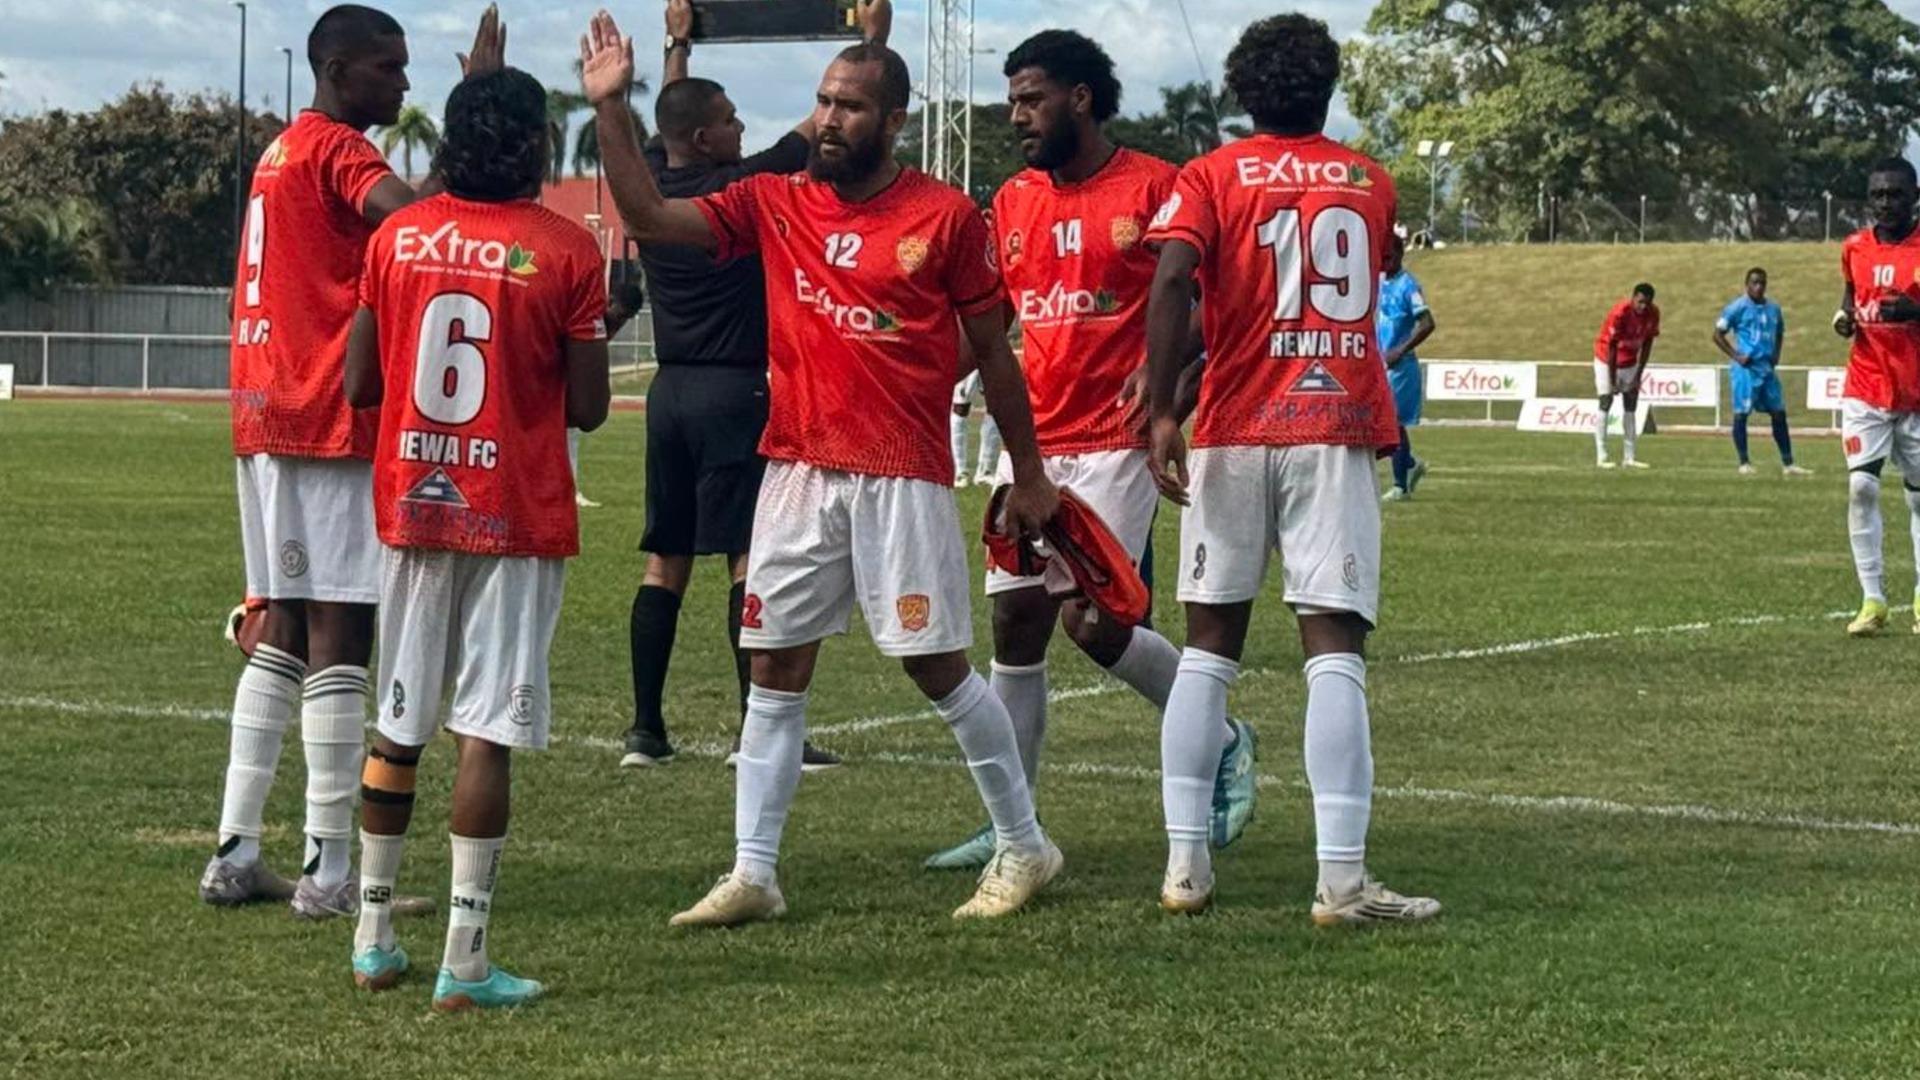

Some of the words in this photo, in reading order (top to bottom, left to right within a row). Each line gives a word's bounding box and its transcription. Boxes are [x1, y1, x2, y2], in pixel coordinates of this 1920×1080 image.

[1236, 151, 1349, 187] Extra
[395, 220, 506, 269] Extra
[824, 232, 864, 269] 12
[1051, 218, 1083, 258] 14
[1257, 206, 1371, 322] 19
[1872, 264, 1895, 288] 10
[1019, 280, 1095, 321] Extra
[413, 291, 492, 425] 6
[1269, 330, 1333, 358] REWA
[1340, 331, 1366, 359] FC
[1443, 367, 1502, 391] Extra
[1639, 371, 1681, 397] xtra
[467, 437, 498, 470] FC
